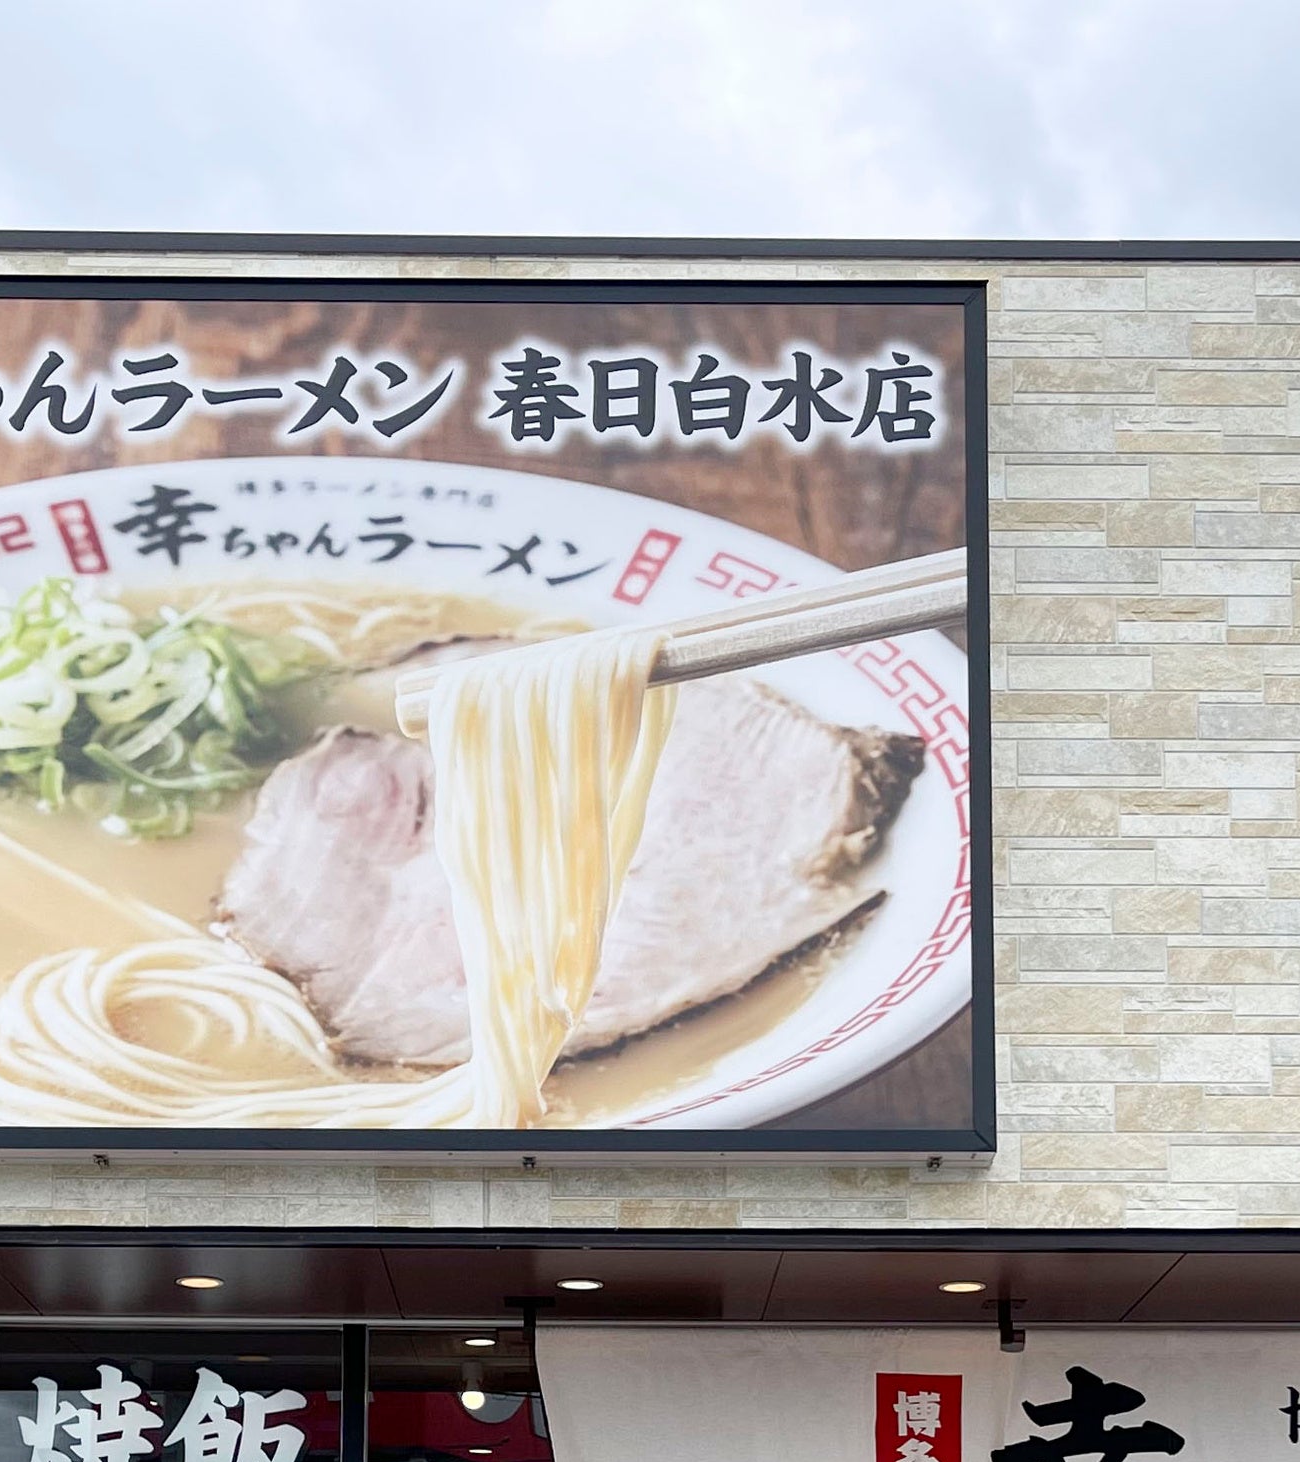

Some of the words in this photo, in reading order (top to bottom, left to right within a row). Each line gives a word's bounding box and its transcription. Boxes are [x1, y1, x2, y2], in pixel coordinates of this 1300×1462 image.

[489, 348, 940, 445] 春日白水店
[112, 484, 613, 586] 幸ちゃんラーメン
